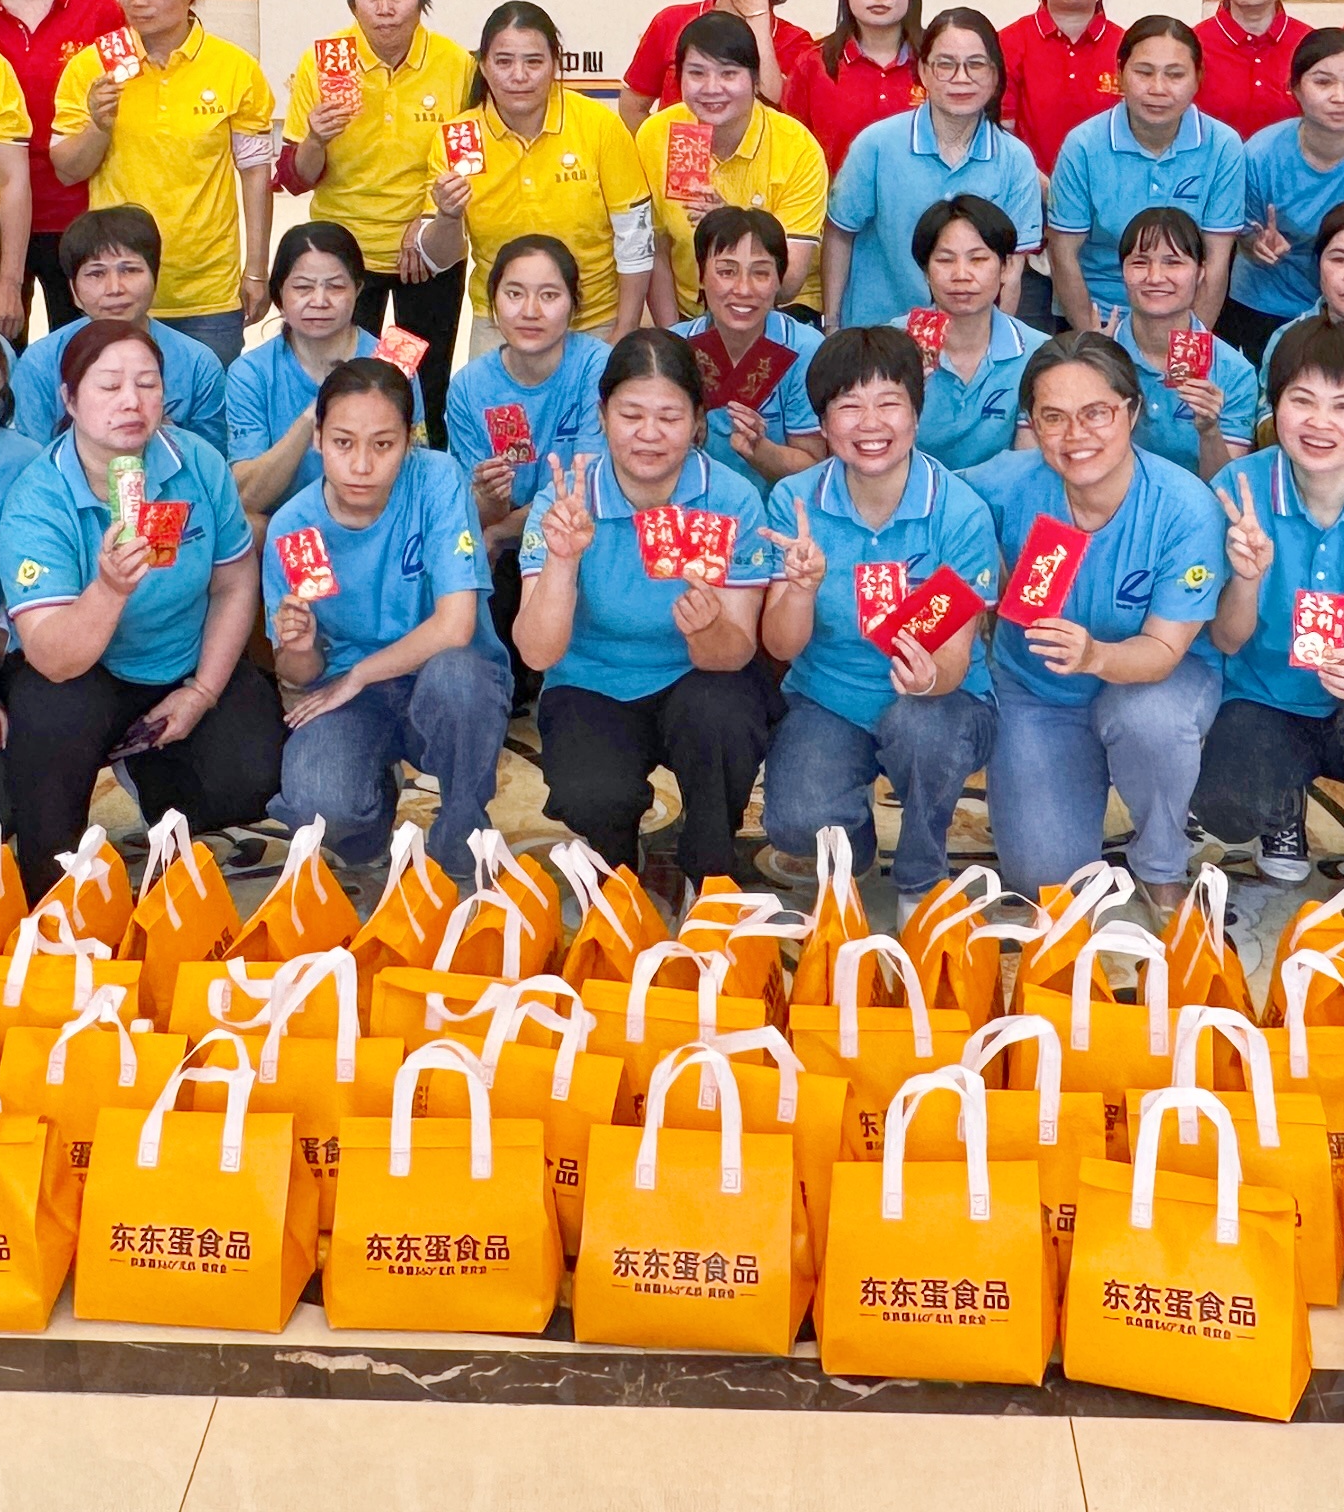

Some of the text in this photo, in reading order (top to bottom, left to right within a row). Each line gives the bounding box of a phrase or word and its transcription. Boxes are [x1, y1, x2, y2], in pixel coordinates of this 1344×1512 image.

[109, 1222, 252, 1262] 东东蛋食品
[365, 1232, 510, 1264] 东东蛋食品
[612, 1246, 760, 1285] 东东蛋食品
[859, 1276, 1011, 1312] 东东蛋食品
[1102, 1279, 1257, 1328] 东东蛋食品
